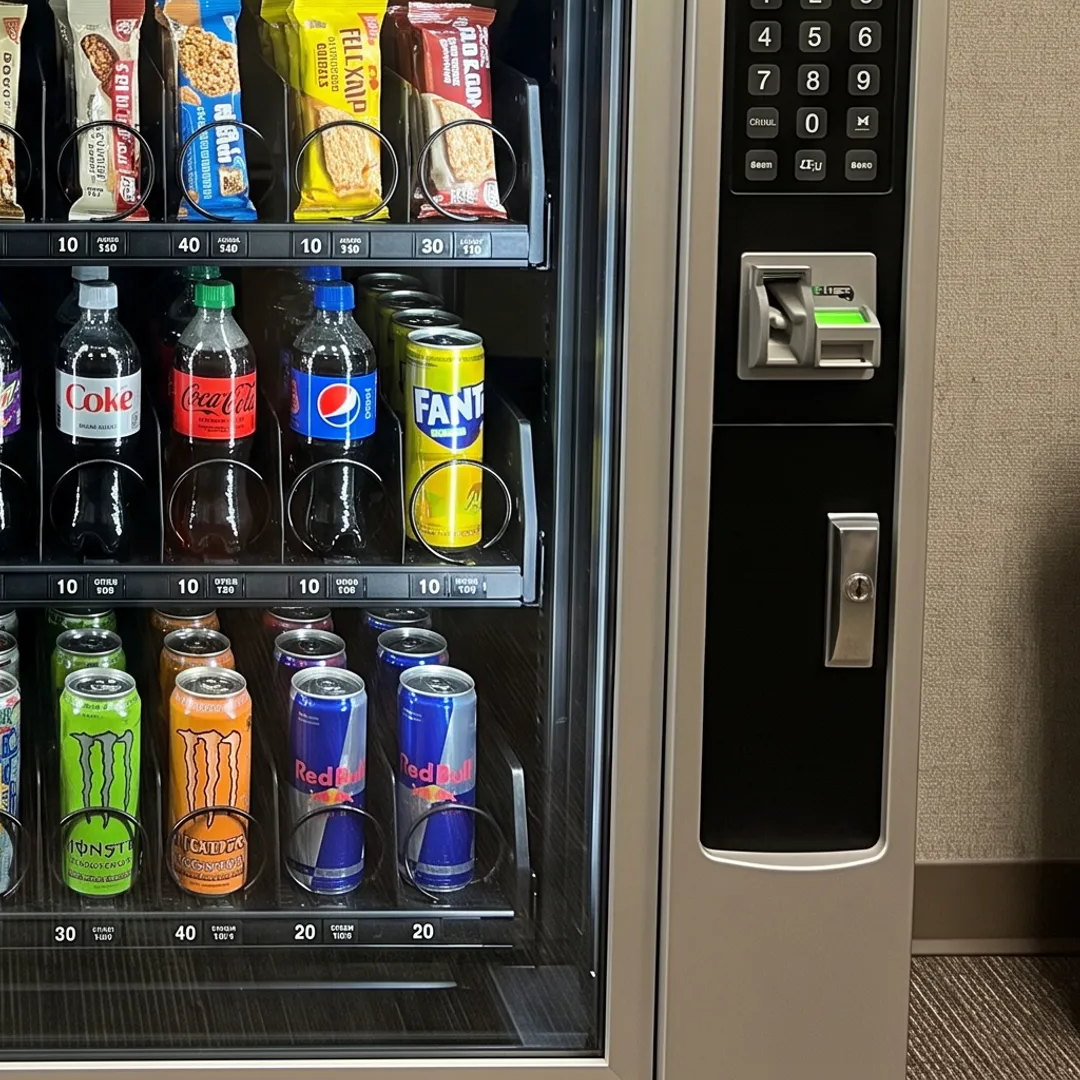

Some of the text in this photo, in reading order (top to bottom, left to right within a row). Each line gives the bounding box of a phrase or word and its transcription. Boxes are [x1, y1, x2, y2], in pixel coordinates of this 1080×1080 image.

[757, 26, 772, 47] 4
[807, 26, 822, 47] 5
[858, 26, 873, 47] 6
[756, 70, 772, 90] 7
[805, 70, 821, 91] 8
[856, 70, 871, 91] 9
[804, 113, 820, 134] 0
[57, 236, 79, 253] 10
[177, 236, 201, 253] 40
[300, 238, 322, 254] 10
[421, 238, 444, 255] 30
[65, 383, 134, 414] Coke
[57, 579, 79, 595] 10
[178, 579, 200, 595] 10
[299, 578, 321, 594] 10
[419, 578, 441, 595] 10
[295, 759, 333, 787] Red
[436, 759, 472, 786] Bull
[54, 926, 77, 942] 30
[174, 924, 197, 941] 40
[293, 923, 317, 940] 20
[412, 923, 435, 940] 20
